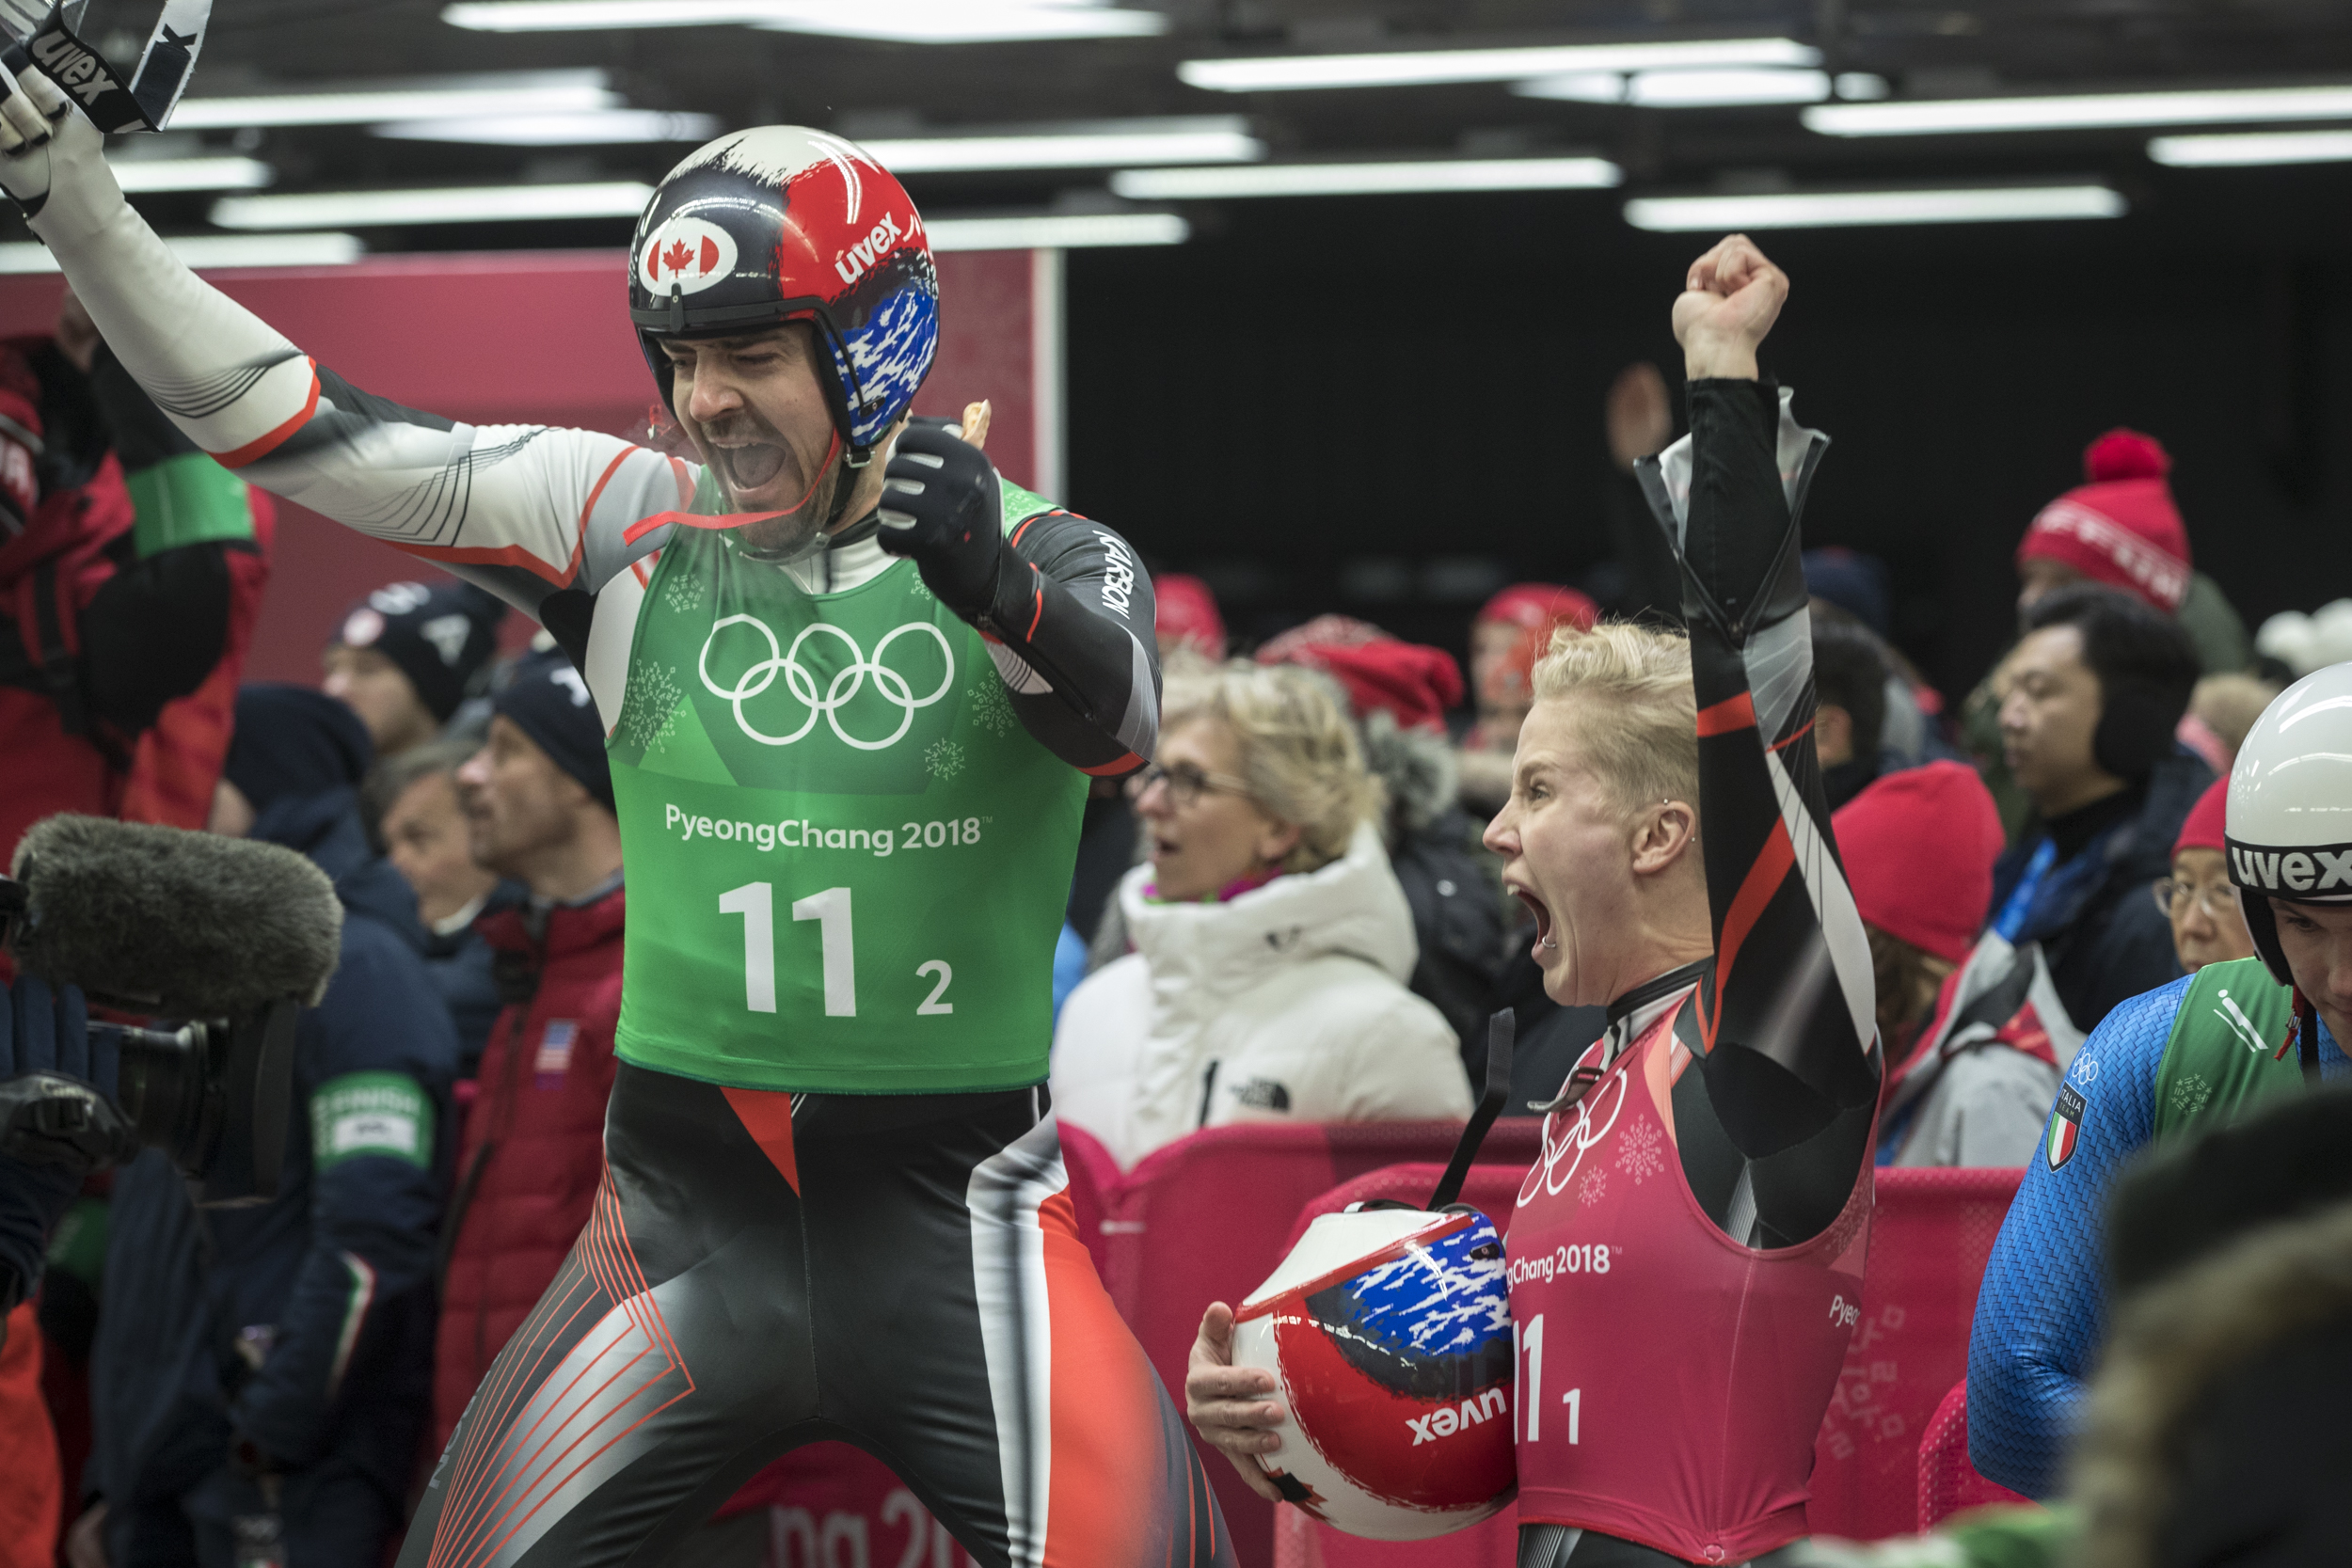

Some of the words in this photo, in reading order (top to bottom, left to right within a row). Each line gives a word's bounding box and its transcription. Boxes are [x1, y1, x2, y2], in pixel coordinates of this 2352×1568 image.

[32, 29, 119, 106] uvex
[834, 211, 901, 284] uvex
[1092, 530, 1134, 620] KARBON
[666, 803, 894, 857] PyeongChang
[901, 816, 981, 848] 2018
[2232, 847, 2352, 891] uvex
[719, 881, 856, 1017] 11
[915, 959, 953, 1015] 2
[2059, 1088, 2081, 1113] ITALIA
[1556, 1243, 1611, 1274] 2018
[1406, 1386, 1507, 1447] uvex
[1563, 1387, 1581, 1445] 1
